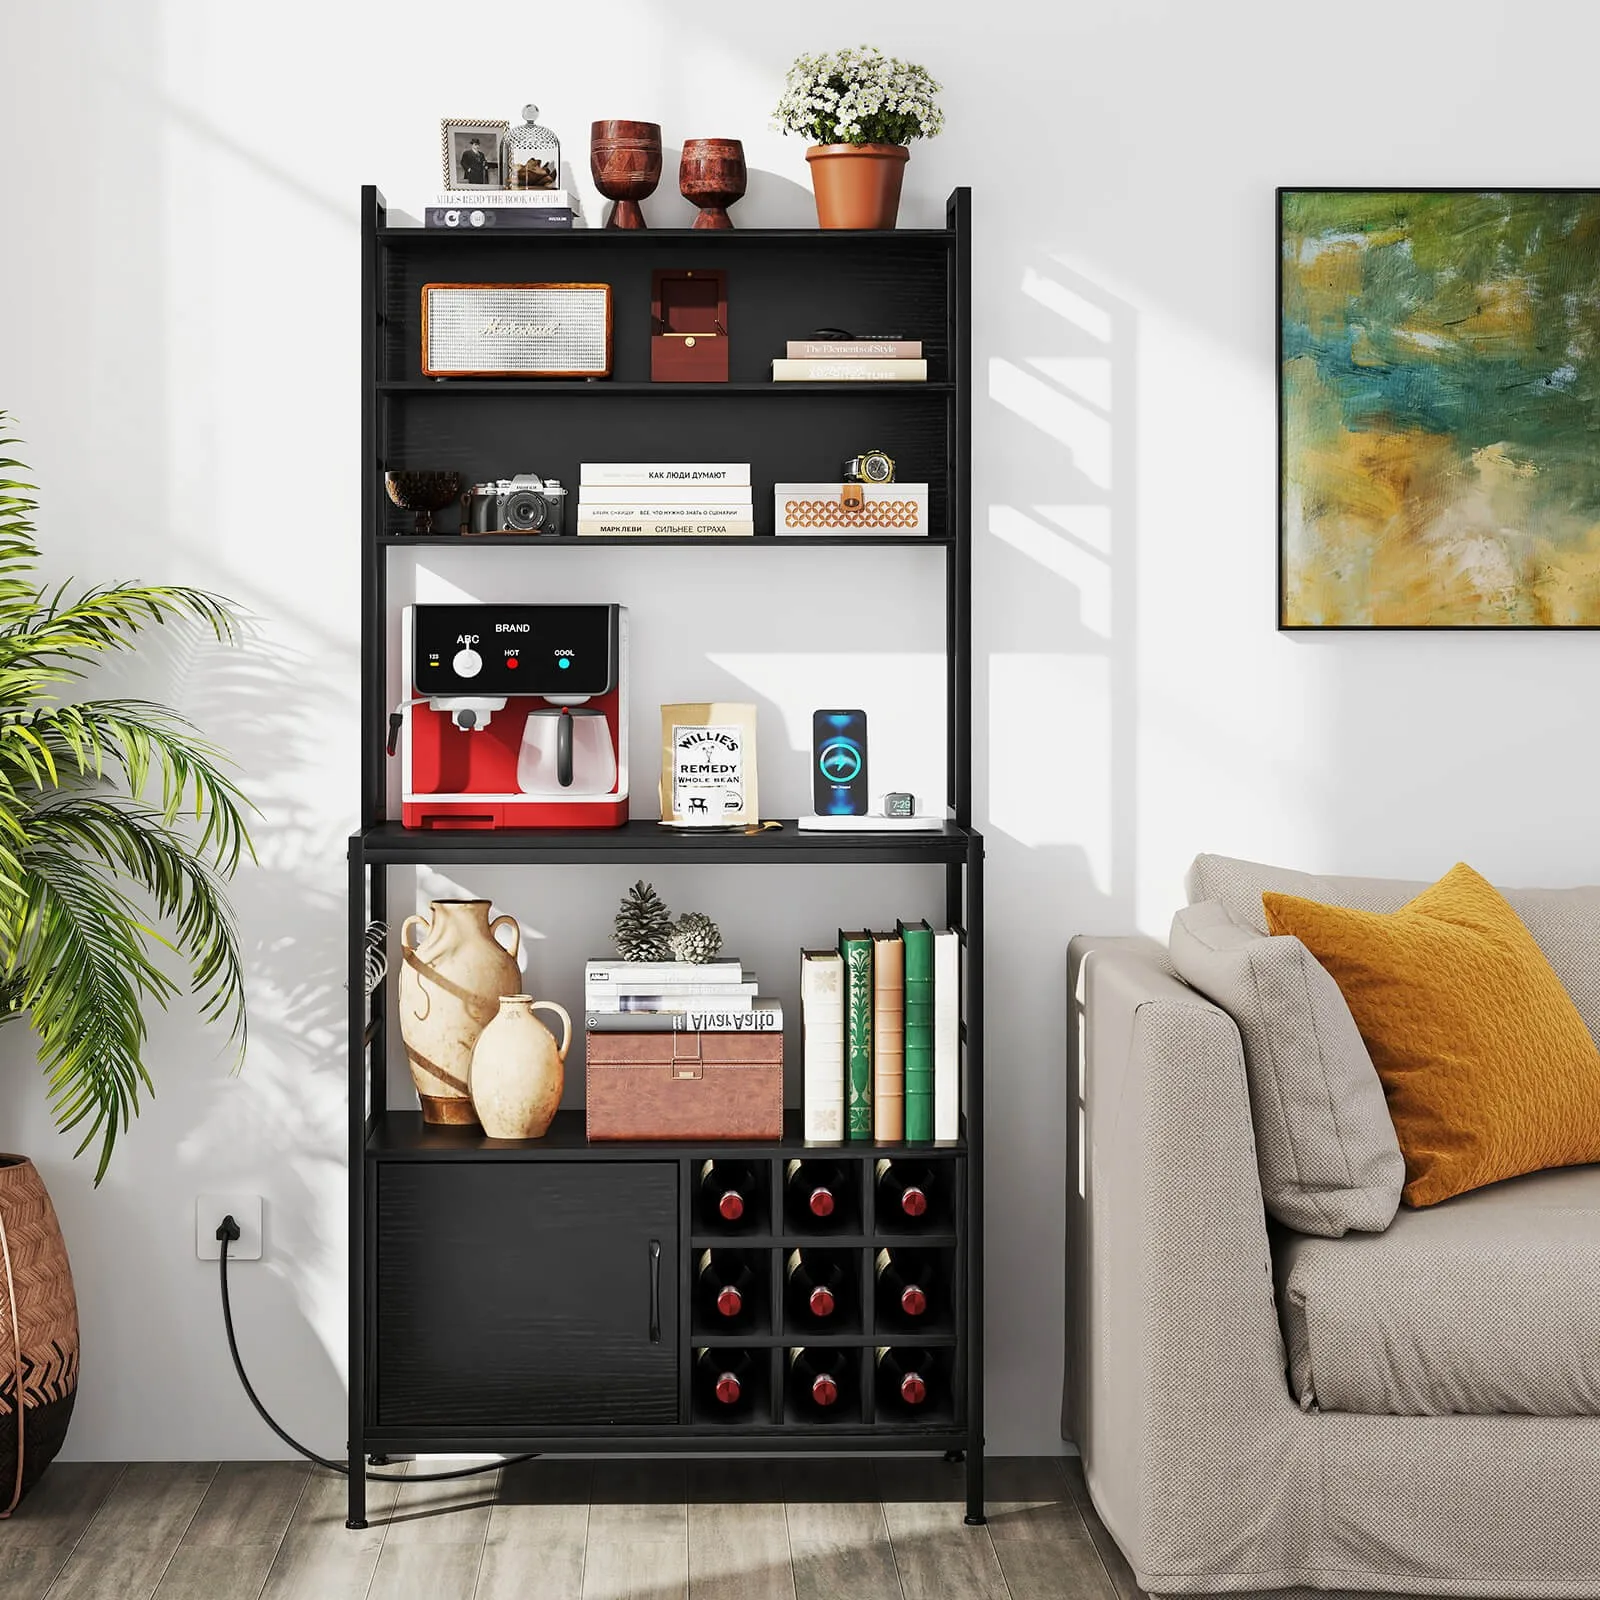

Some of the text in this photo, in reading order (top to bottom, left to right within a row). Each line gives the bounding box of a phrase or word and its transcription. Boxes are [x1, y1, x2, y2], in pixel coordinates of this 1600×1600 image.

[486, 194, 503, 204] THE
[505, 194, 528, 204] BOOK
[804, 343, 897, 354] The Elements of Style
[648, 471, 664, 479] КАК
[666, 471, 691, 480] ЛЮДИ
[692, 471, 727, 480] ДУМАЮТ
[655, 525, 726, 534] СИЛЬНЕЕ СТРАХА
[495, 623, 531, 633] BRAND
[456, 634, 480, 644] ABC
[504, 649, 520, 657] HOT
[554, 649, 575, 657] COOL
[678, 731, 739, 751] WILLIE'S
[681, 765, 737, 773] REMEDY
[678, 776, 740, 784] WHOLE BEAN
